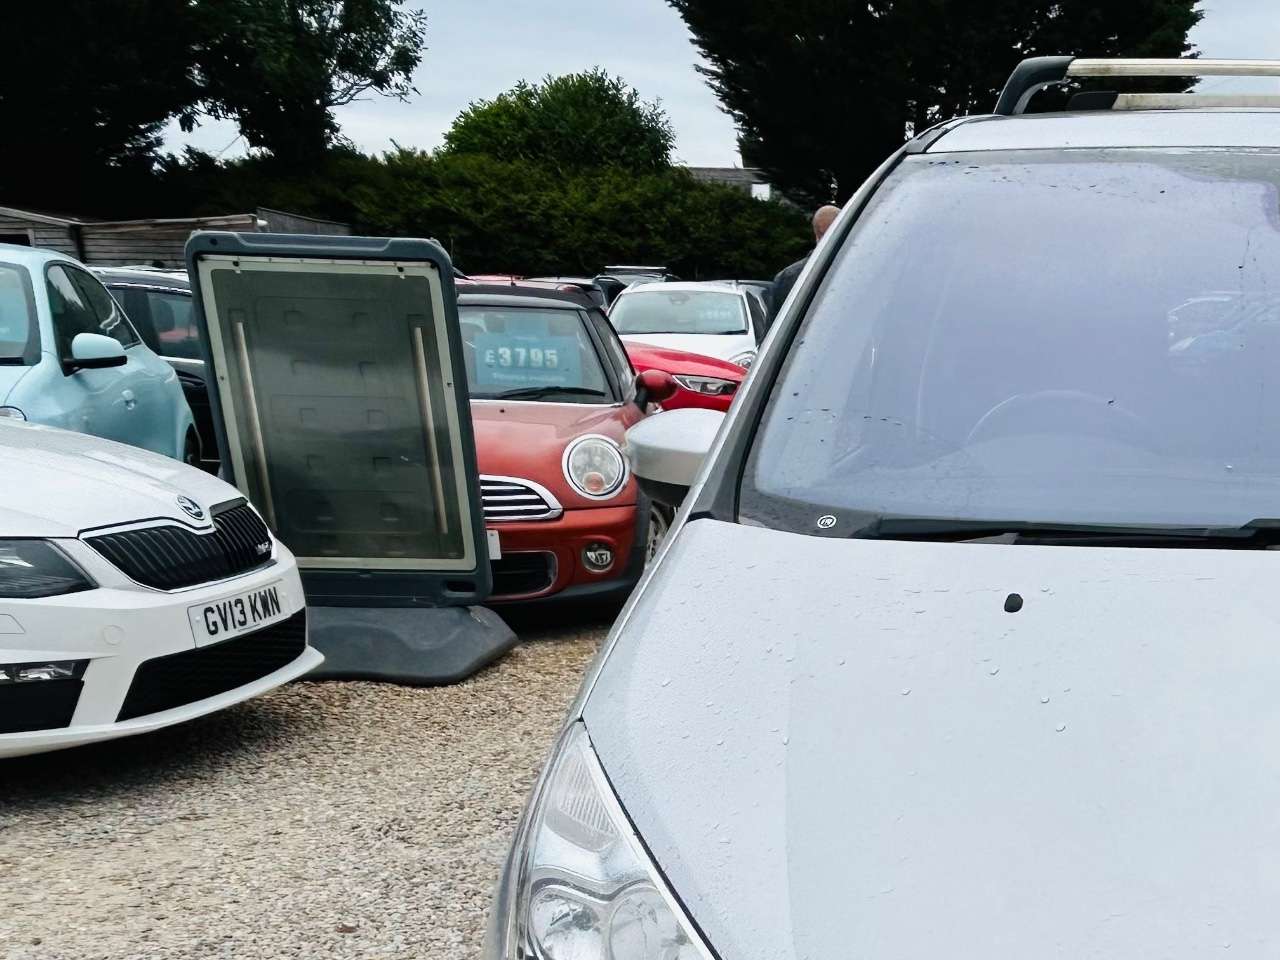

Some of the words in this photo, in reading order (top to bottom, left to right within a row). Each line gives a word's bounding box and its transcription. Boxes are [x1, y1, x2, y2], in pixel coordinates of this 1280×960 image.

[485, 347, 558, 368] £3795
[203, 598, 247, 636] GV13
[248, 586, 281, 622] KWN
